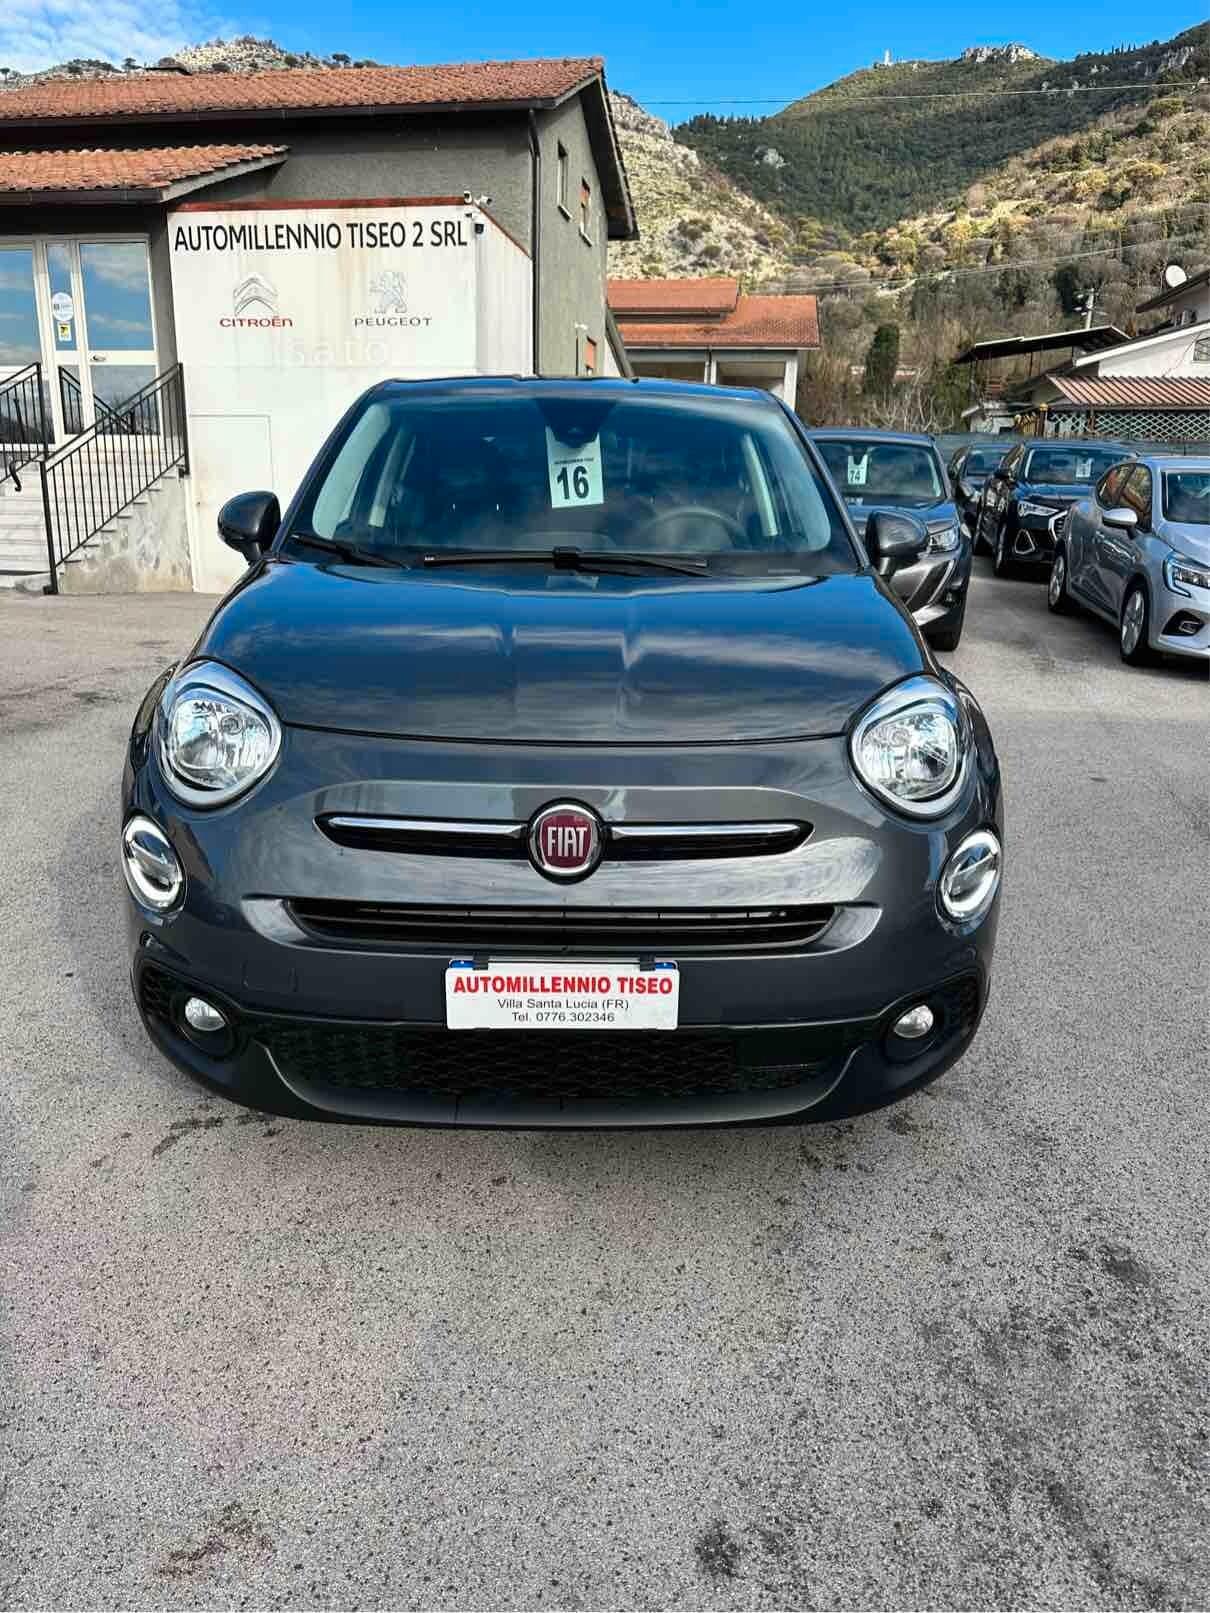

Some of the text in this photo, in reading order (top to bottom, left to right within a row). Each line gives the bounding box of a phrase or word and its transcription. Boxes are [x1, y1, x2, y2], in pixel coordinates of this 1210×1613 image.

[174, 220, 468, 251] AUTOMILLENNIO TISEO 2 SRL
[354, 317, 432, 327] PEUGEOT
[557, 465, 589, 500] 16
[547, 826, 588, 857] FIAT
[453, 976, 673, 994] AUTOMILLENNIO TISEO
[497, 998, 629, 1010] Villa Santa Lucia (FR)
[512, 1012, 615, 1022] Tel. 0776.302346
